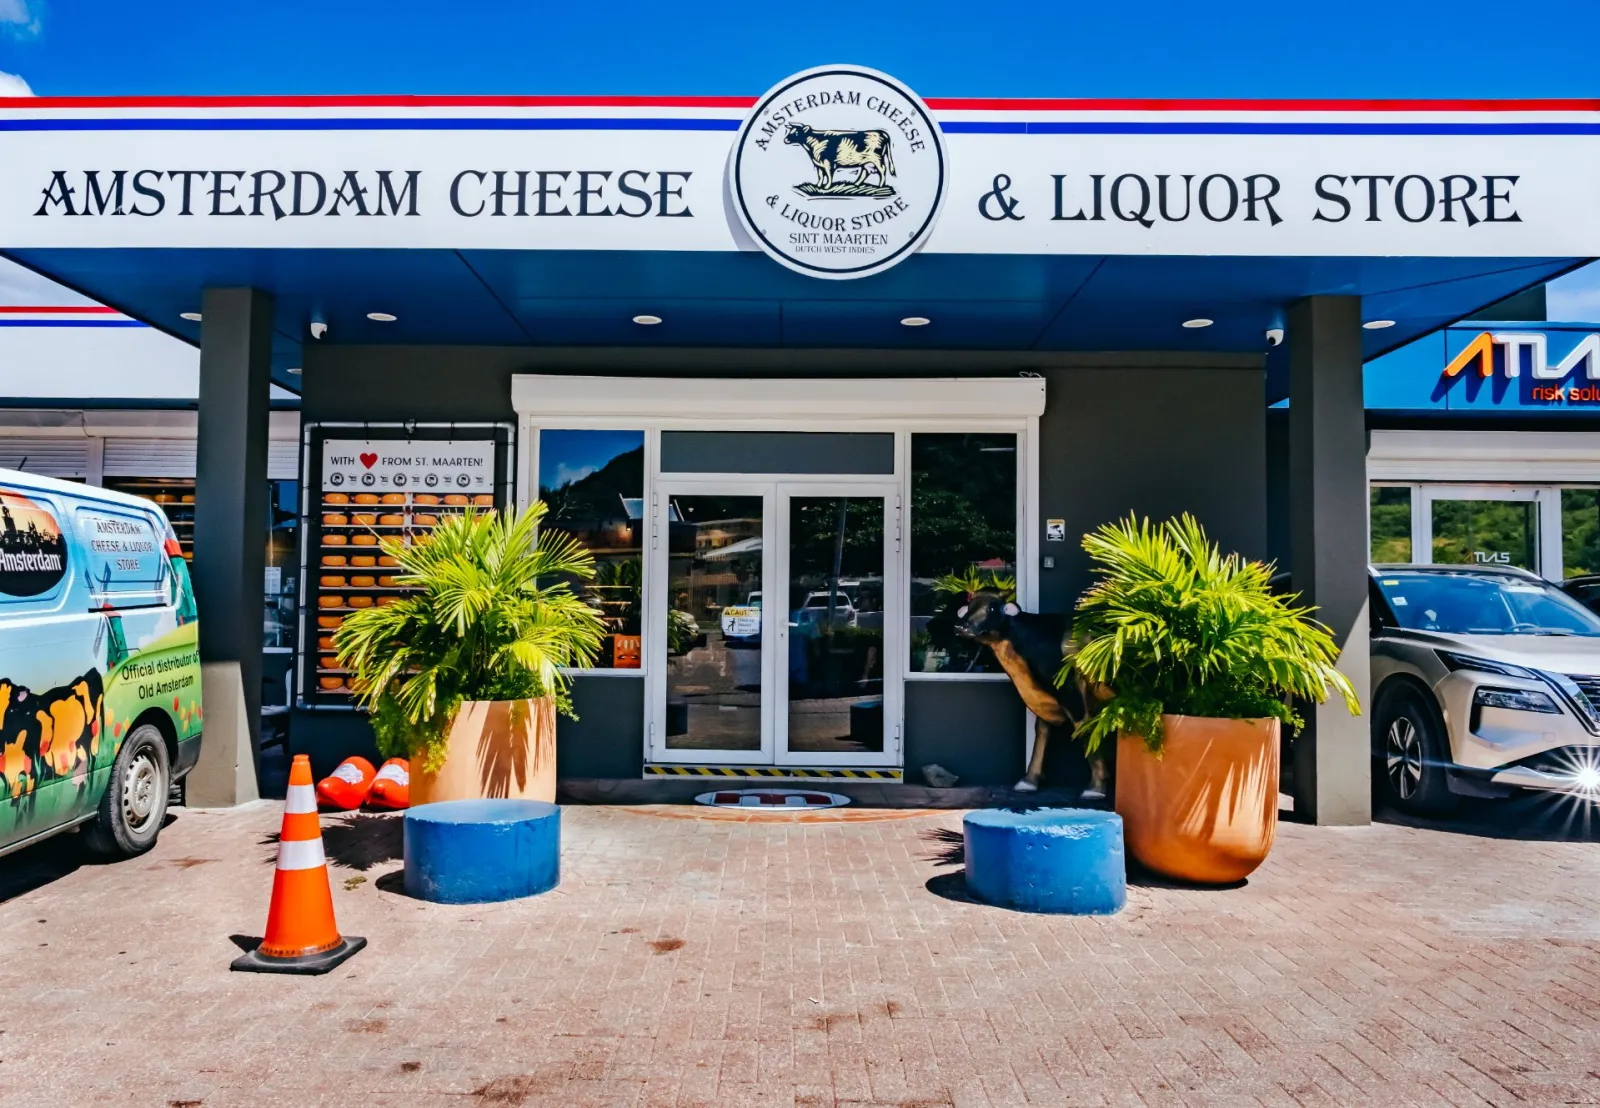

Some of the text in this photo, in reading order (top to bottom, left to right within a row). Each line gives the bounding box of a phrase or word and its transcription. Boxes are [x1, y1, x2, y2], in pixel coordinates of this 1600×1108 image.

[755, 91, 925, 154] AMSTERDAM CHEESE
[34, 170, 693, 220] AMSTERDAM CHEESE
[979, 174, 1522, 229] & LIQUOR STORE
[766, 194, 910, 232] & LIQUOR STORE
[789, 233, 888, 245] SINT MAARTEN
[795, 245, 822, 253] DUTCH
[849, 246, 876, 254] INDIES
[1532, 384, 1565, 400] risk
[331, 457, 483, 467] WITH FROM ST. MAARTEN!
[96, 521, 141, 535] AMSTERDAM
[91, 540, 153, 553] CHEESE & LIQUOR
[0, 548, 62, 571] Amsterdam
[117, 559, 140, 571] STORE
[1464, 551, 1510, 563] ATLAS
[122, 661, 155, 680] Official
[156, 653, 192, 674] distributor
[138, 675, 194, 700] Old Amsterdam
